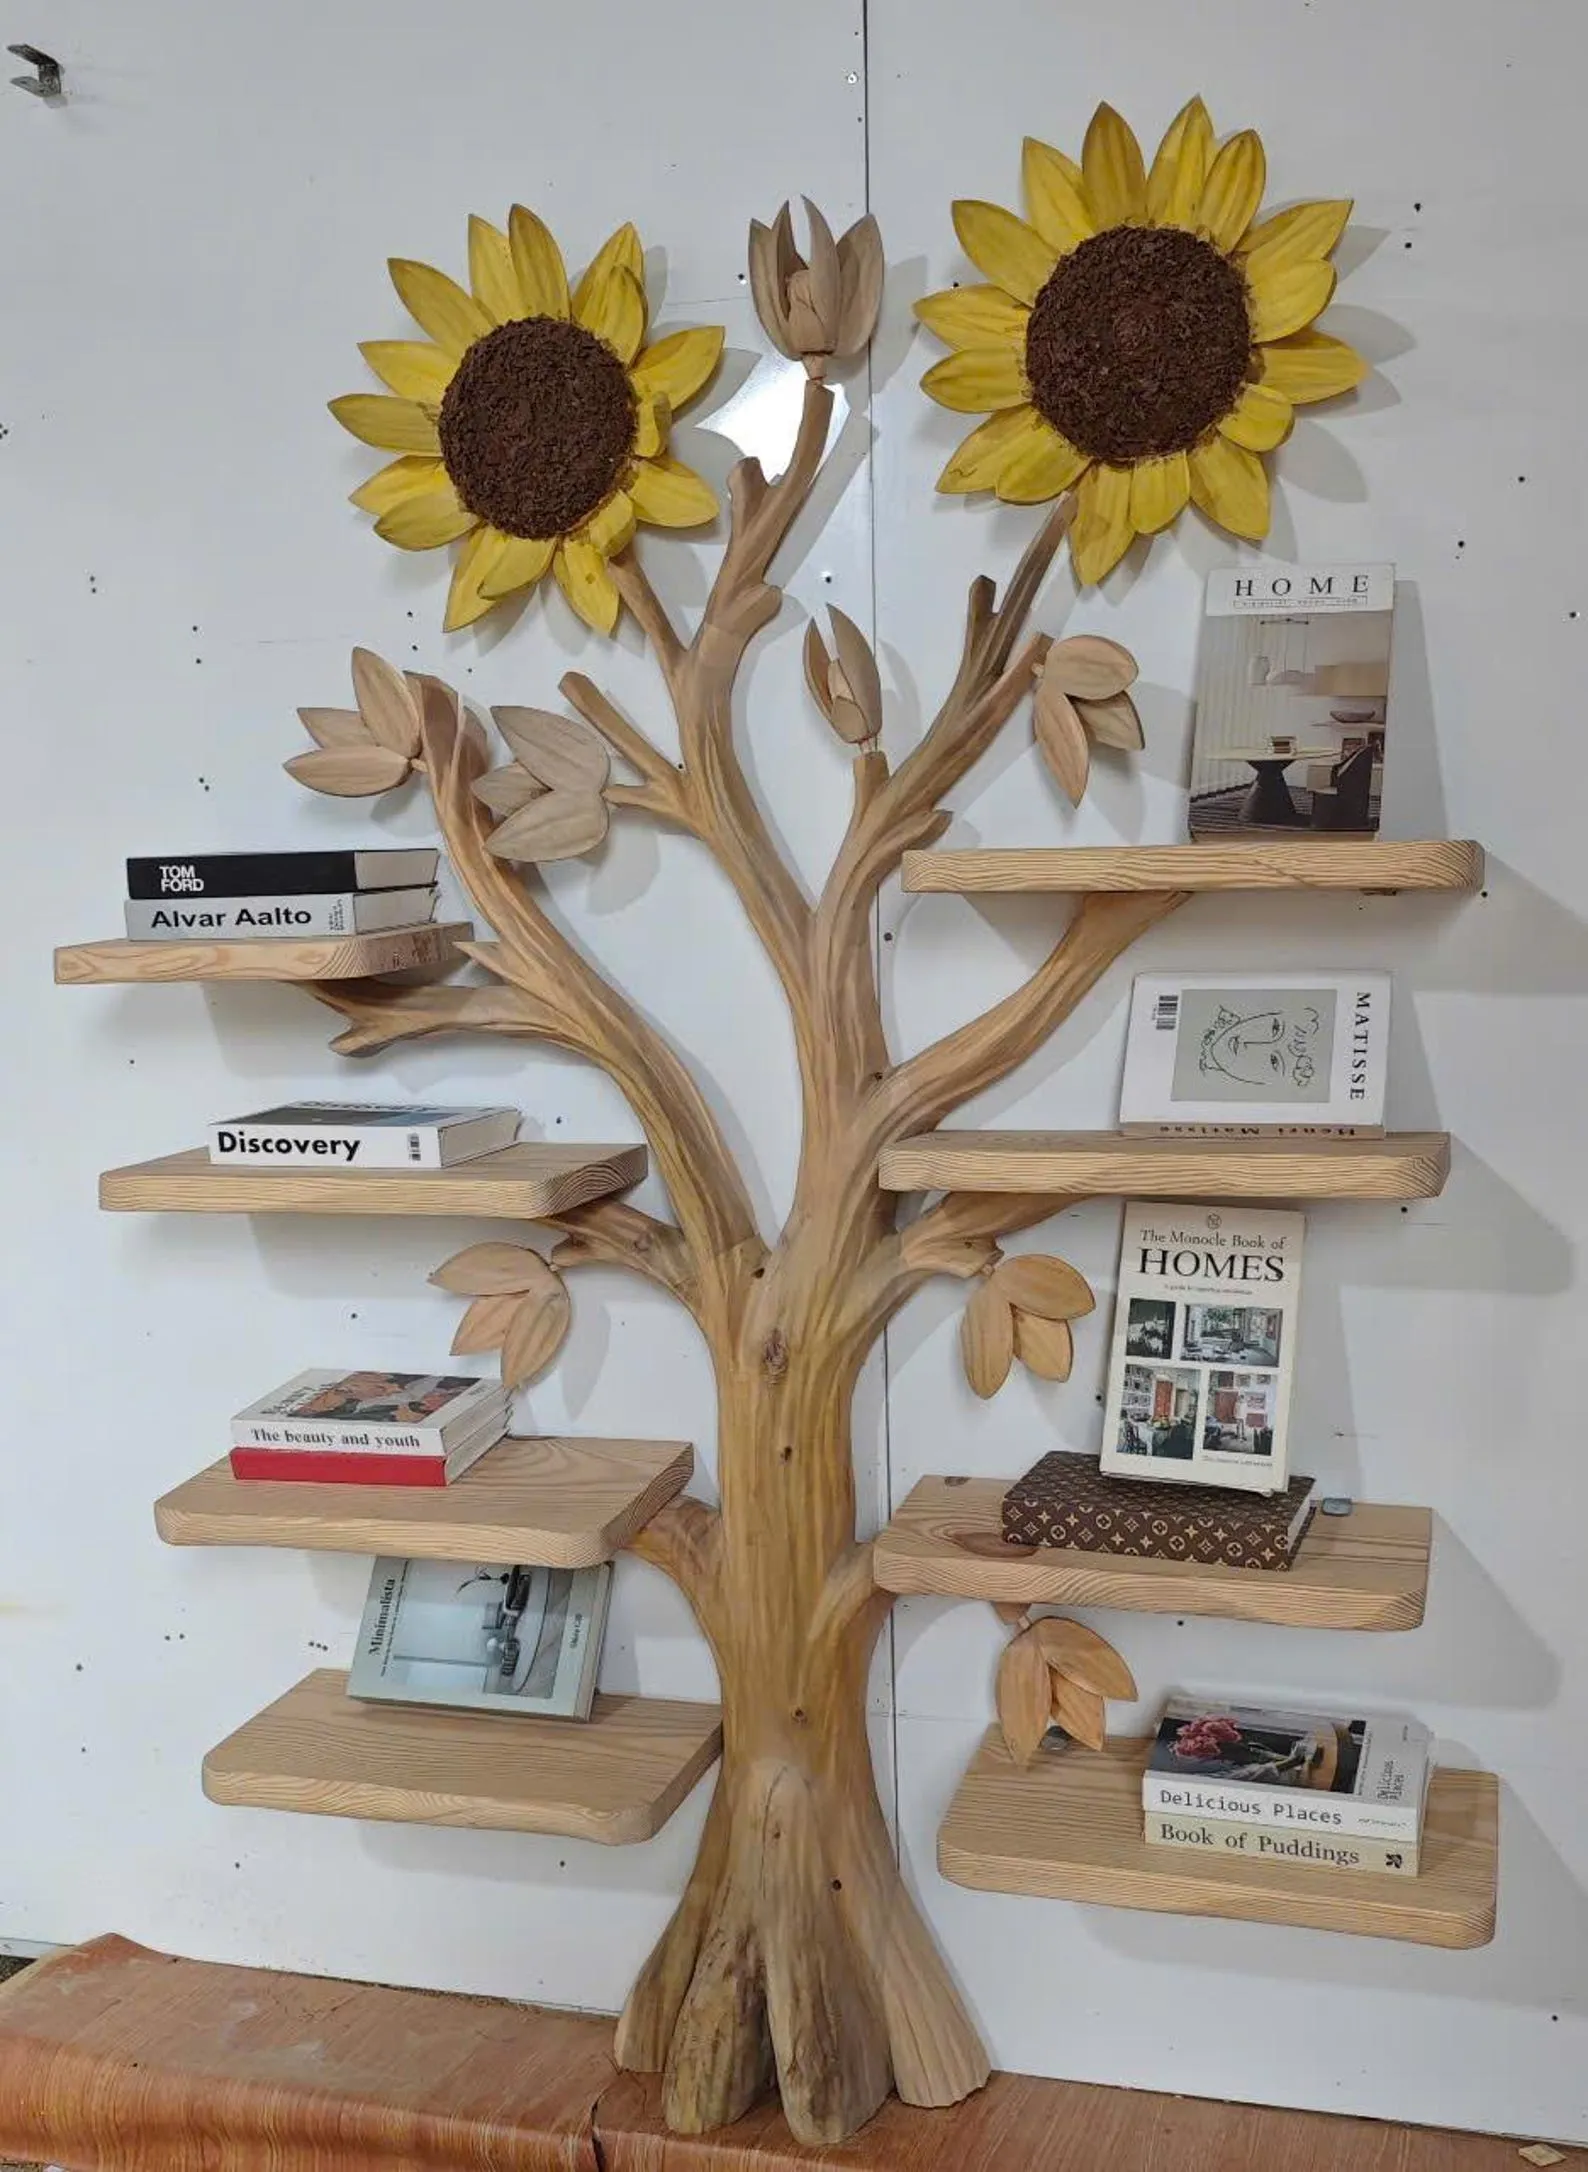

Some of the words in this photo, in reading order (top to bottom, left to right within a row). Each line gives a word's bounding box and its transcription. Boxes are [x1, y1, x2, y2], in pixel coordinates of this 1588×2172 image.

[1235, 575, 1369, 597] HOME
[159, 865, 195, 879] TOM
[160, 878, 204, 892] FORD
[151, 910, 226, 928] Alvar
[234, 906, 312, 927] Aalto
[1350, 992, 1372, 1100] MATISSE
[1277, 1124, 1356, 1136] Henri
[217, 1130, 361, 1161] Discovery
[1139, 1229, 1166, 1243] The
[1169, 1231, 1227, 1247] Monocle
[1232, 1234, 1265, 1249] Book
[1270, 1236, 1287, 1250] of
[1138, 1247, 1285, 1282] HOMES
[252, 1428, 280, 1442] The
[284, 1430, 336, 1446] beauty
[341, 1432, 370, 1446] and
[375, 1433, 421, 1448] youth
[368, 1577, 396, 1657] Minimalista
[1160, 1789, 1262, 1815] Delicious
[1273, 1803, 1343, 1826] Places
[1160, 1822, 1215, 1846] Book
[1225, 1832, 1249, 1850] of
[1259, 1834, 1361, 1867] Puddings
